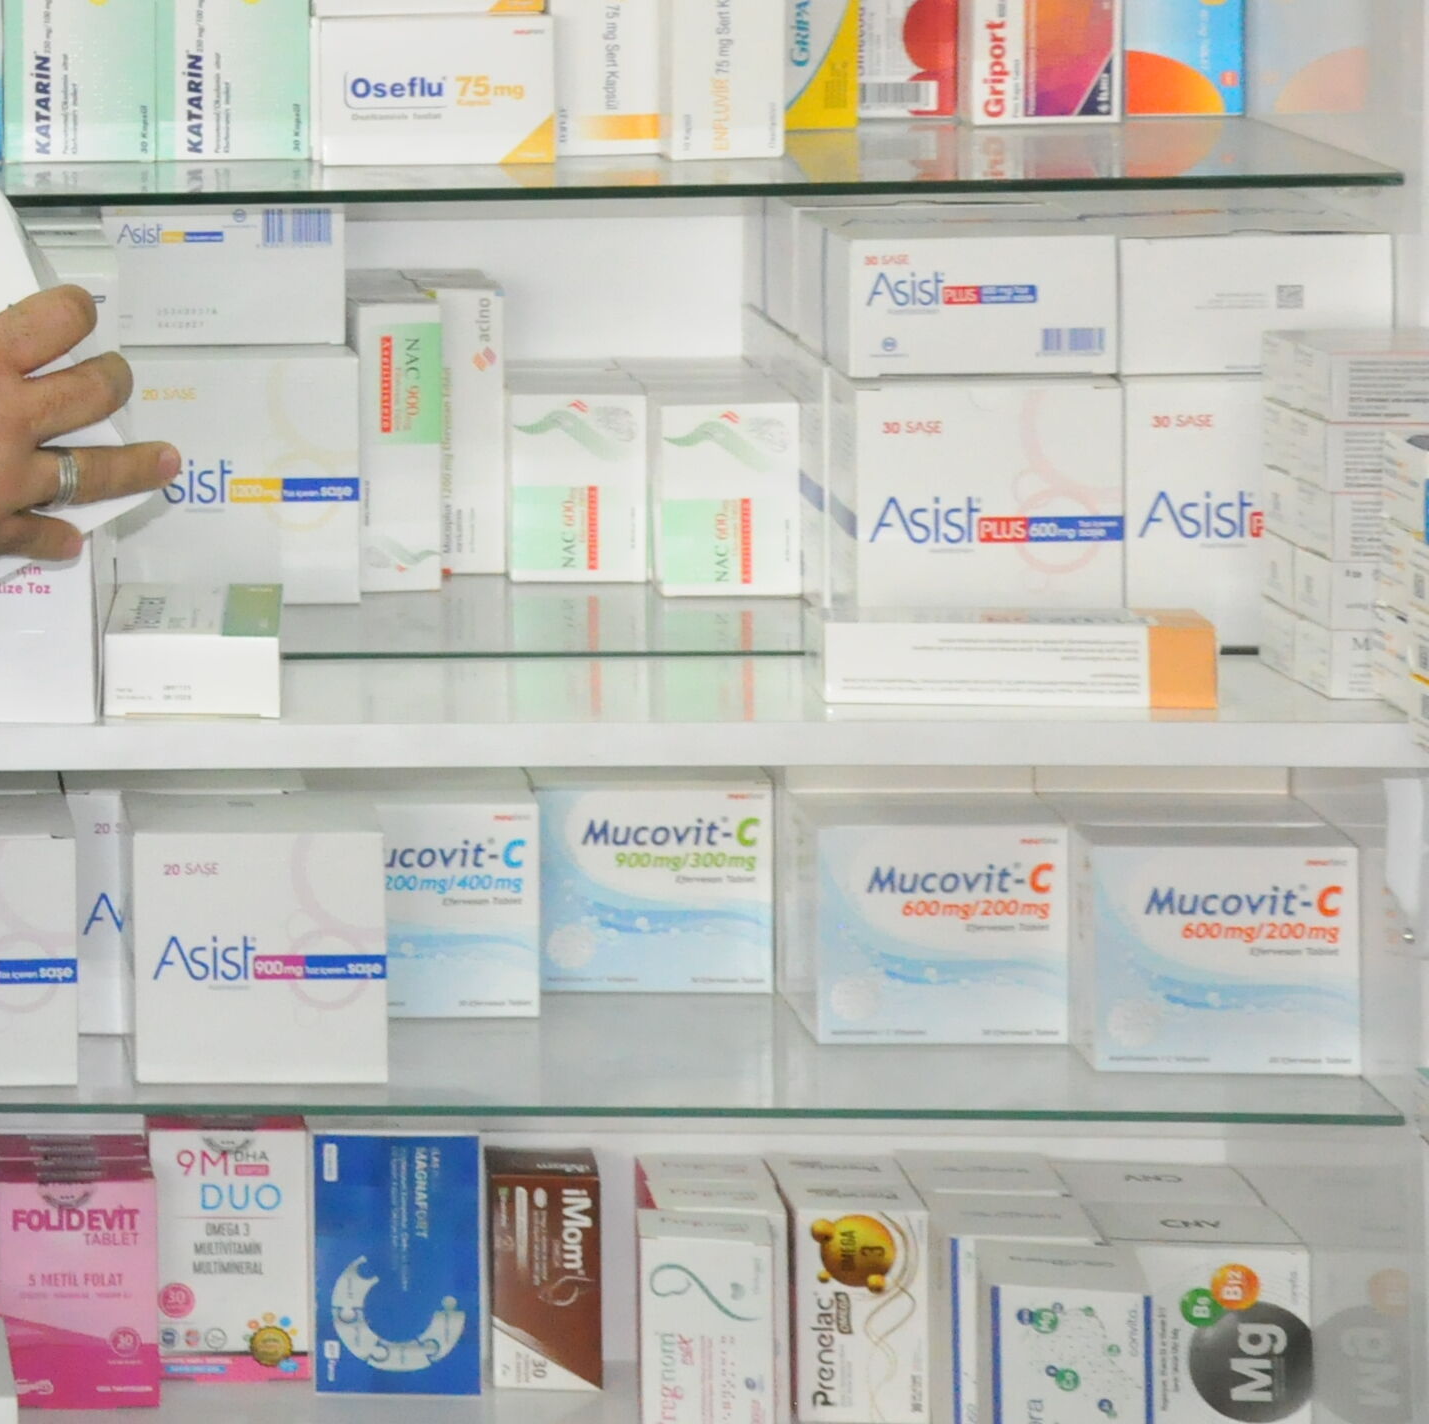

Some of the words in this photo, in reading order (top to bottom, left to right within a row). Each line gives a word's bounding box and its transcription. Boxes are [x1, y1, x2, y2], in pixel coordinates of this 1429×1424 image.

[983, 19, 1009, 119] Griport
[350, 76, 444, 99] Oseflu
[117, 222, 162, 246] Asist
[867, 271, 943, 307] Asist
[944, 287, 978, 304] PLUS
[477, 297, 491, 343] acino
[405, 338, 421, 375] NAC
[869, 496, 981, 543] Asist
[980, 518, 1026, 541] PLUS
[1138, 490, 1253, 539] Asist
[562, 540, 577, 569] NAC
[27, 582, 51, 595] Toz
[581, 817, 760, 848] Mucovit-C
[866, 862, 1055, 896] Mucovit-C
[1145, 885, 1344, 919] Mucovit-C
[153, 934, 251, 982] Asist
[176, 1150, 230, 1176] 9M
[201, 1183, 282, 1211] DUO
[83, 1232, 140, 1246] TABLET
[206, 1223, 237, 1236] OMEGA
[561, 1188, 593, 1269] iMom
[812, 1293, 837, 1408] Prenelac
[1231, 1323, 1288, 1403] Mg
